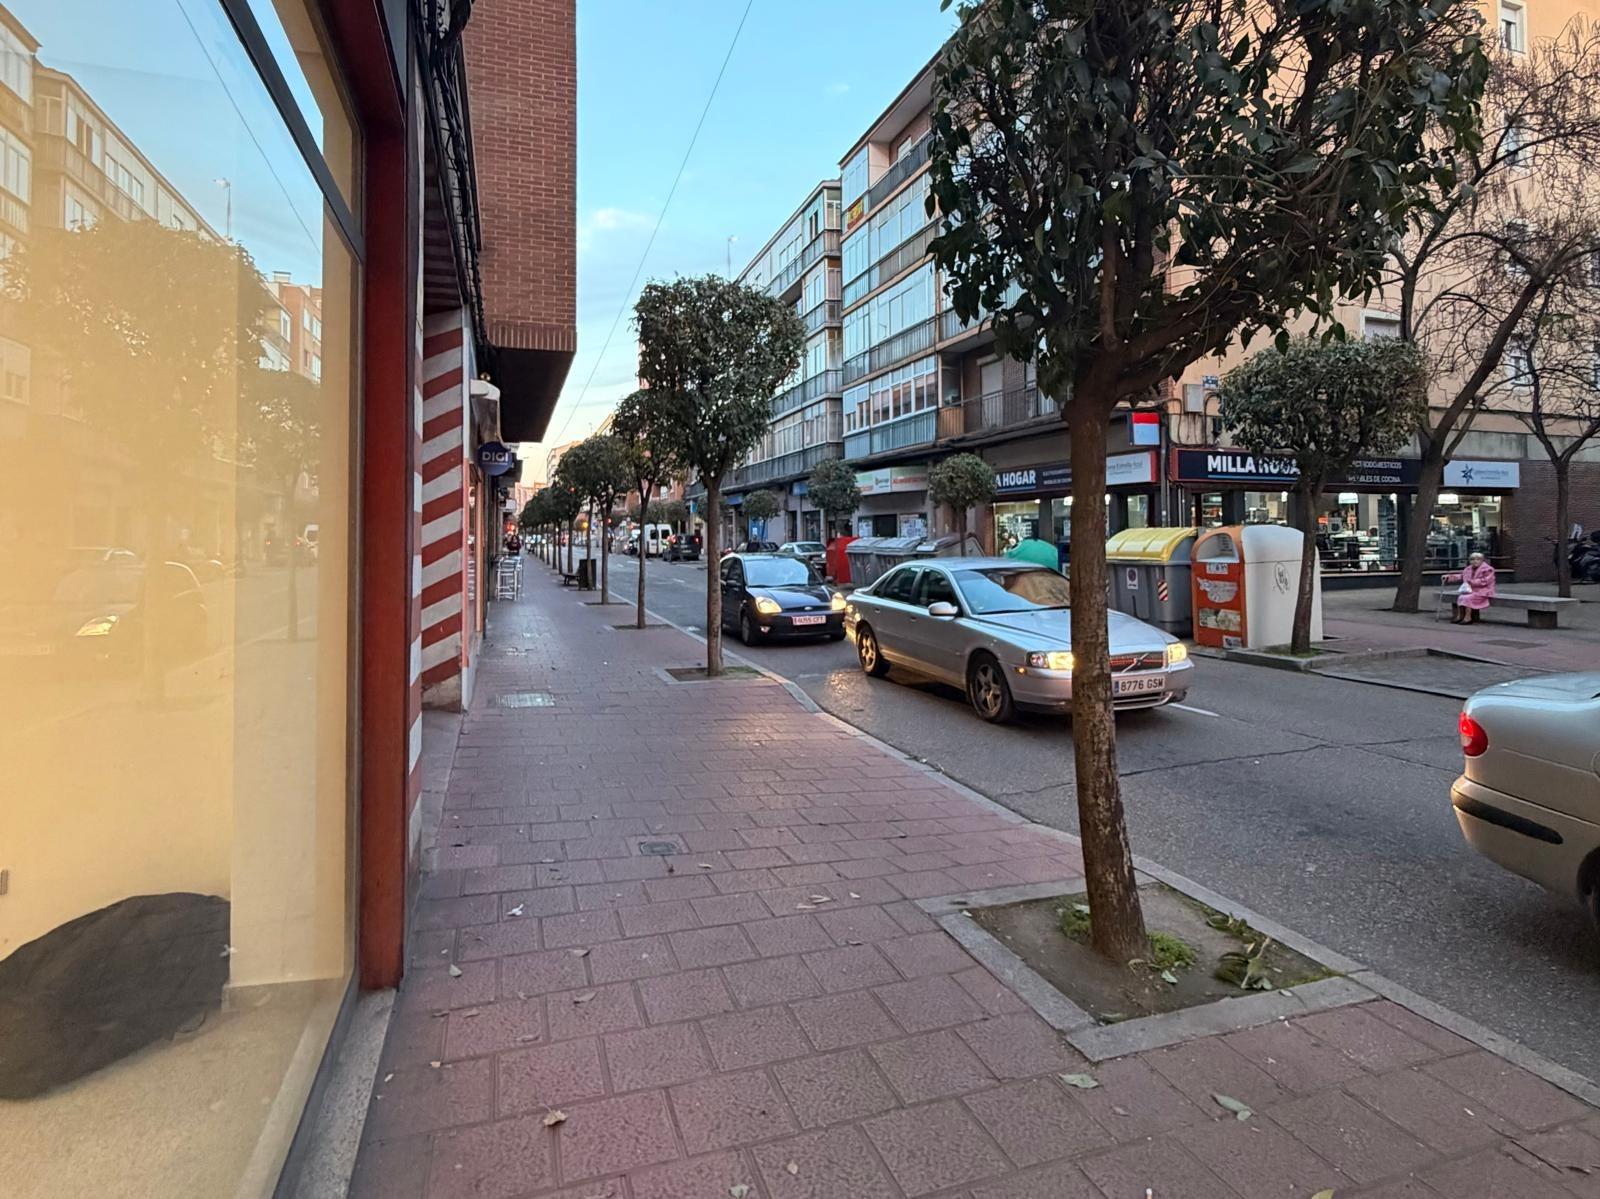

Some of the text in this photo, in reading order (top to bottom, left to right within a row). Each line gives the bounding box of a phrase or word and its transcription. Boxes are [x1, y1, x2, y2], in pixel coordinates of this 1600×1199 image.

[482, 451, 508, 462] DIGI
[1207, 455, 1257, 474] MILLA
[1002, 469, 1036, 487] HOGAR
[1120, 680, 1144, 692] 8776
